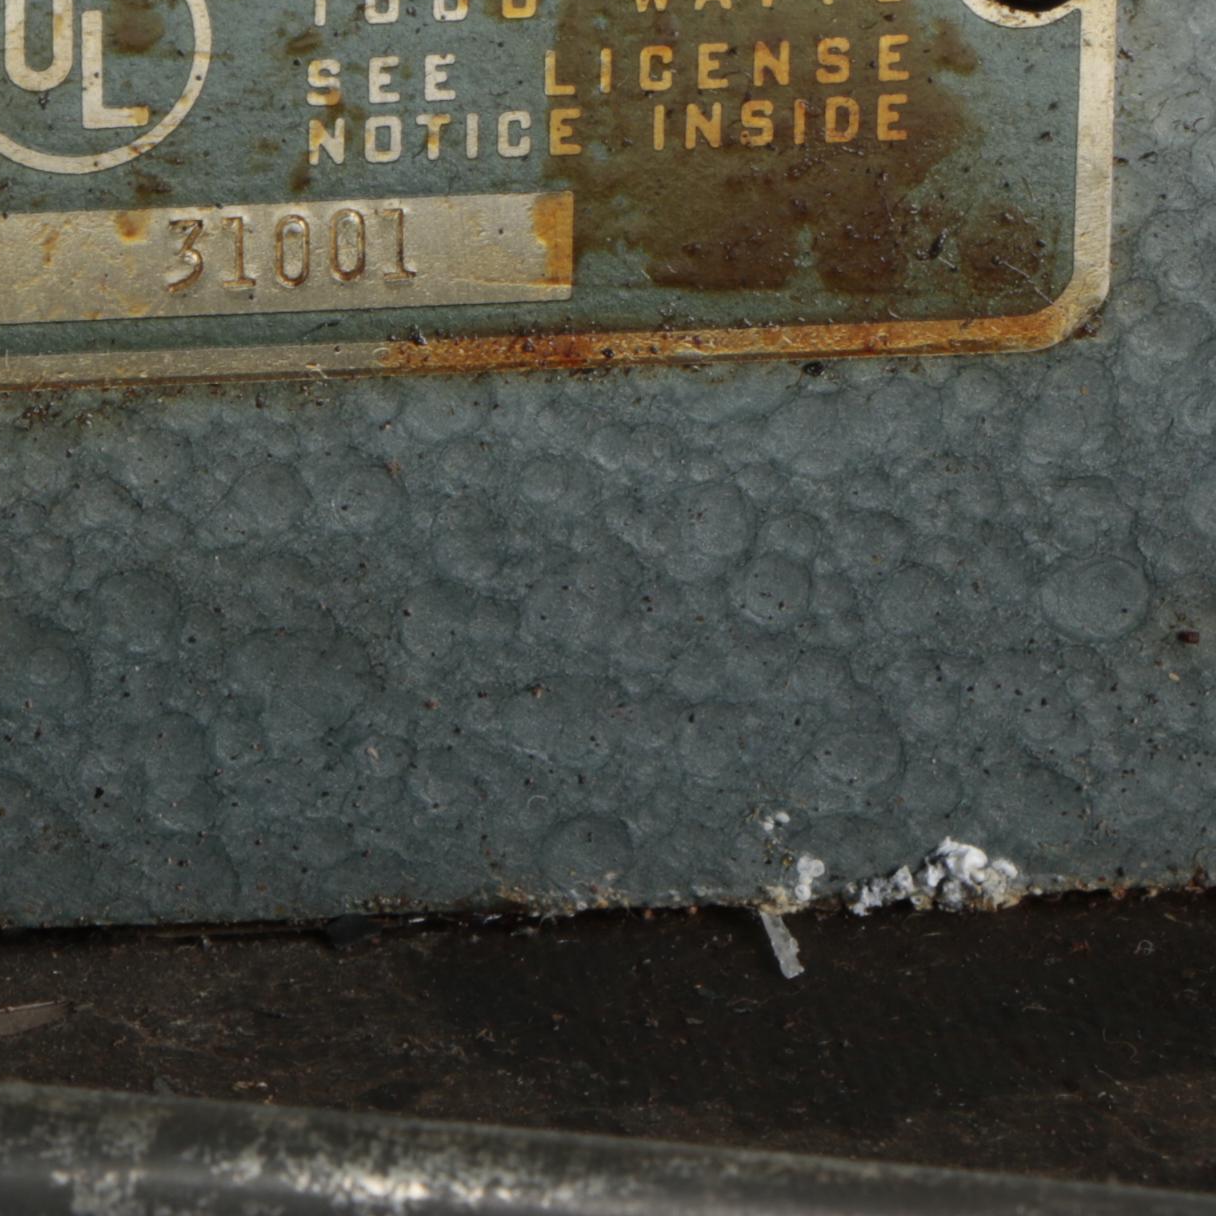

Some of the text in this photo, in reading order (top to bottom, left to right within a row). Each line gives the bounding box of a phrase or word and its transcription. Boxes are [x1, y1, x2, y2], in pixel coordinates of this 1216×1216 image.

[305, 34, 910, 106] SEE LICENSE
[308, 93, 909, 165] NOTICE INSIDE
[166, 208, 420, 295] 31001
